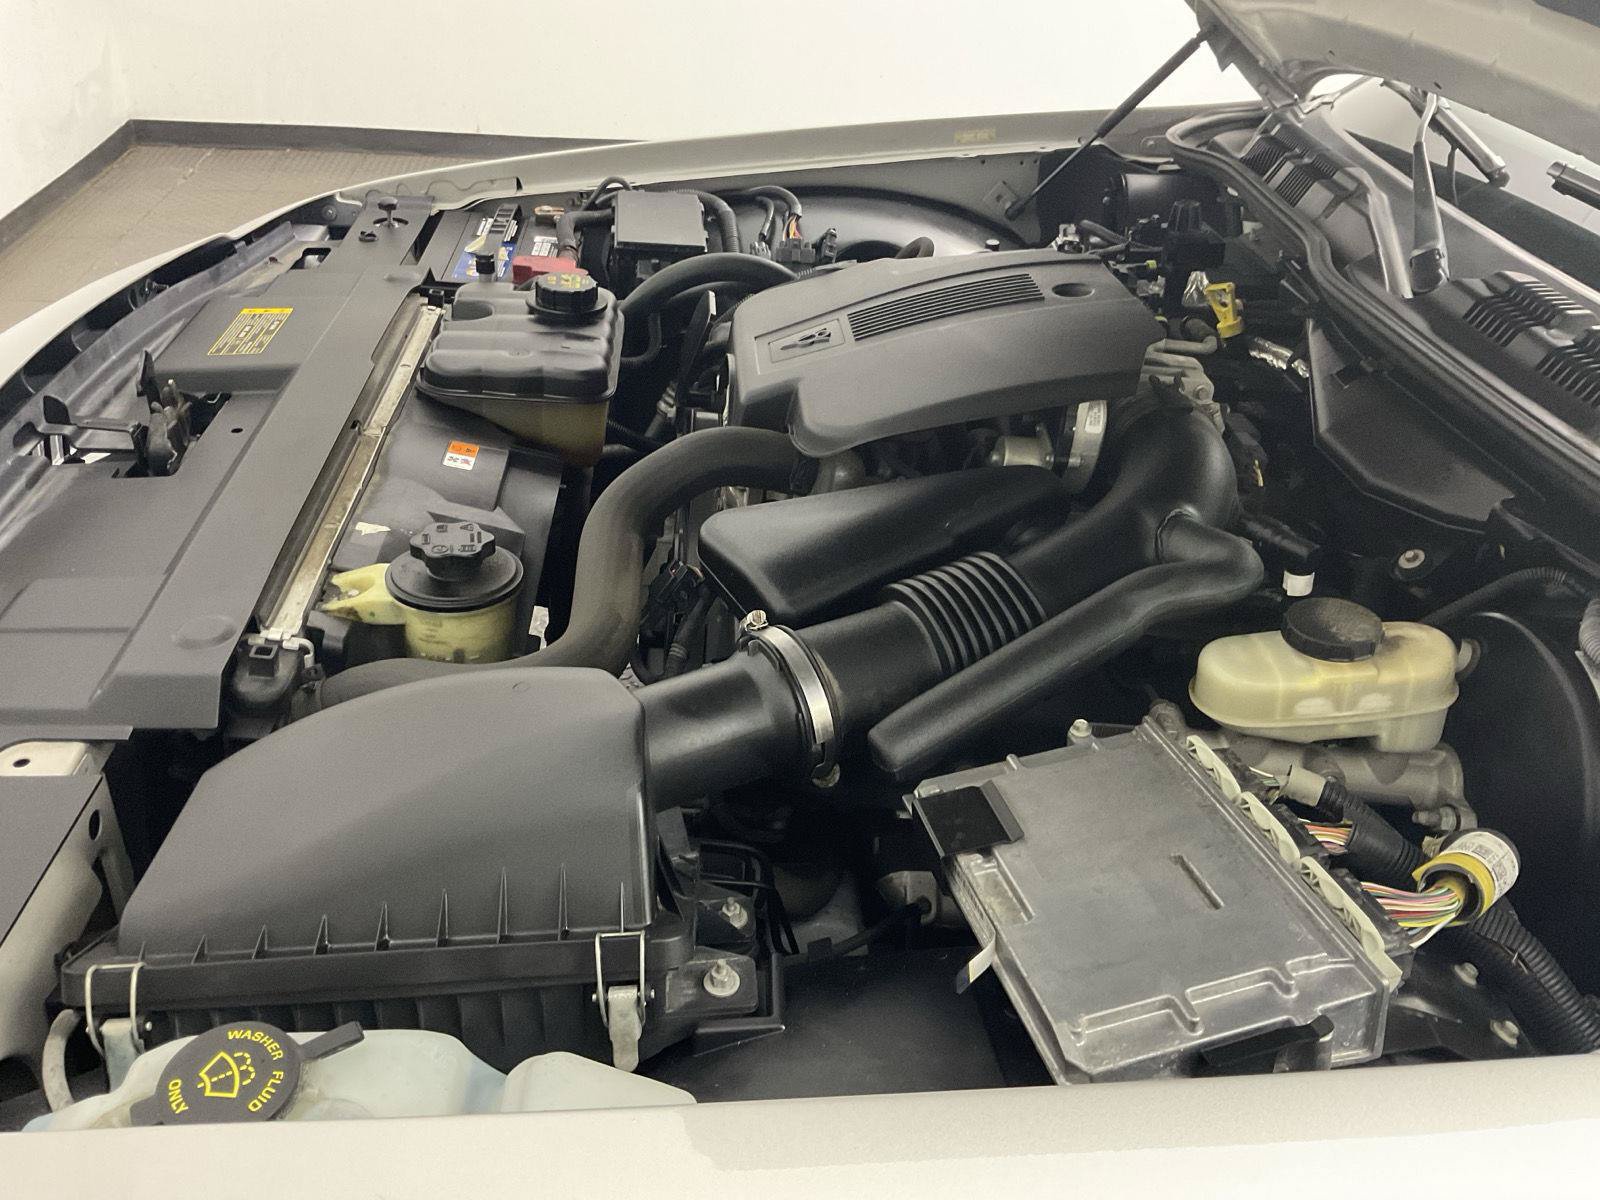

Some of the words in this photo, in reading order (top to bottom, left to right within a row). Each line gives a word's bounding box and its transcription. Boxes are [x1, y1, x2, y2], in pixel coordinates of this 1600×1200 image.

[227, 1029, 284, 1061] WASHER
[168, 1078, 189, 1115] ONLY
[248, 1070, 284, 1112] FLUID
